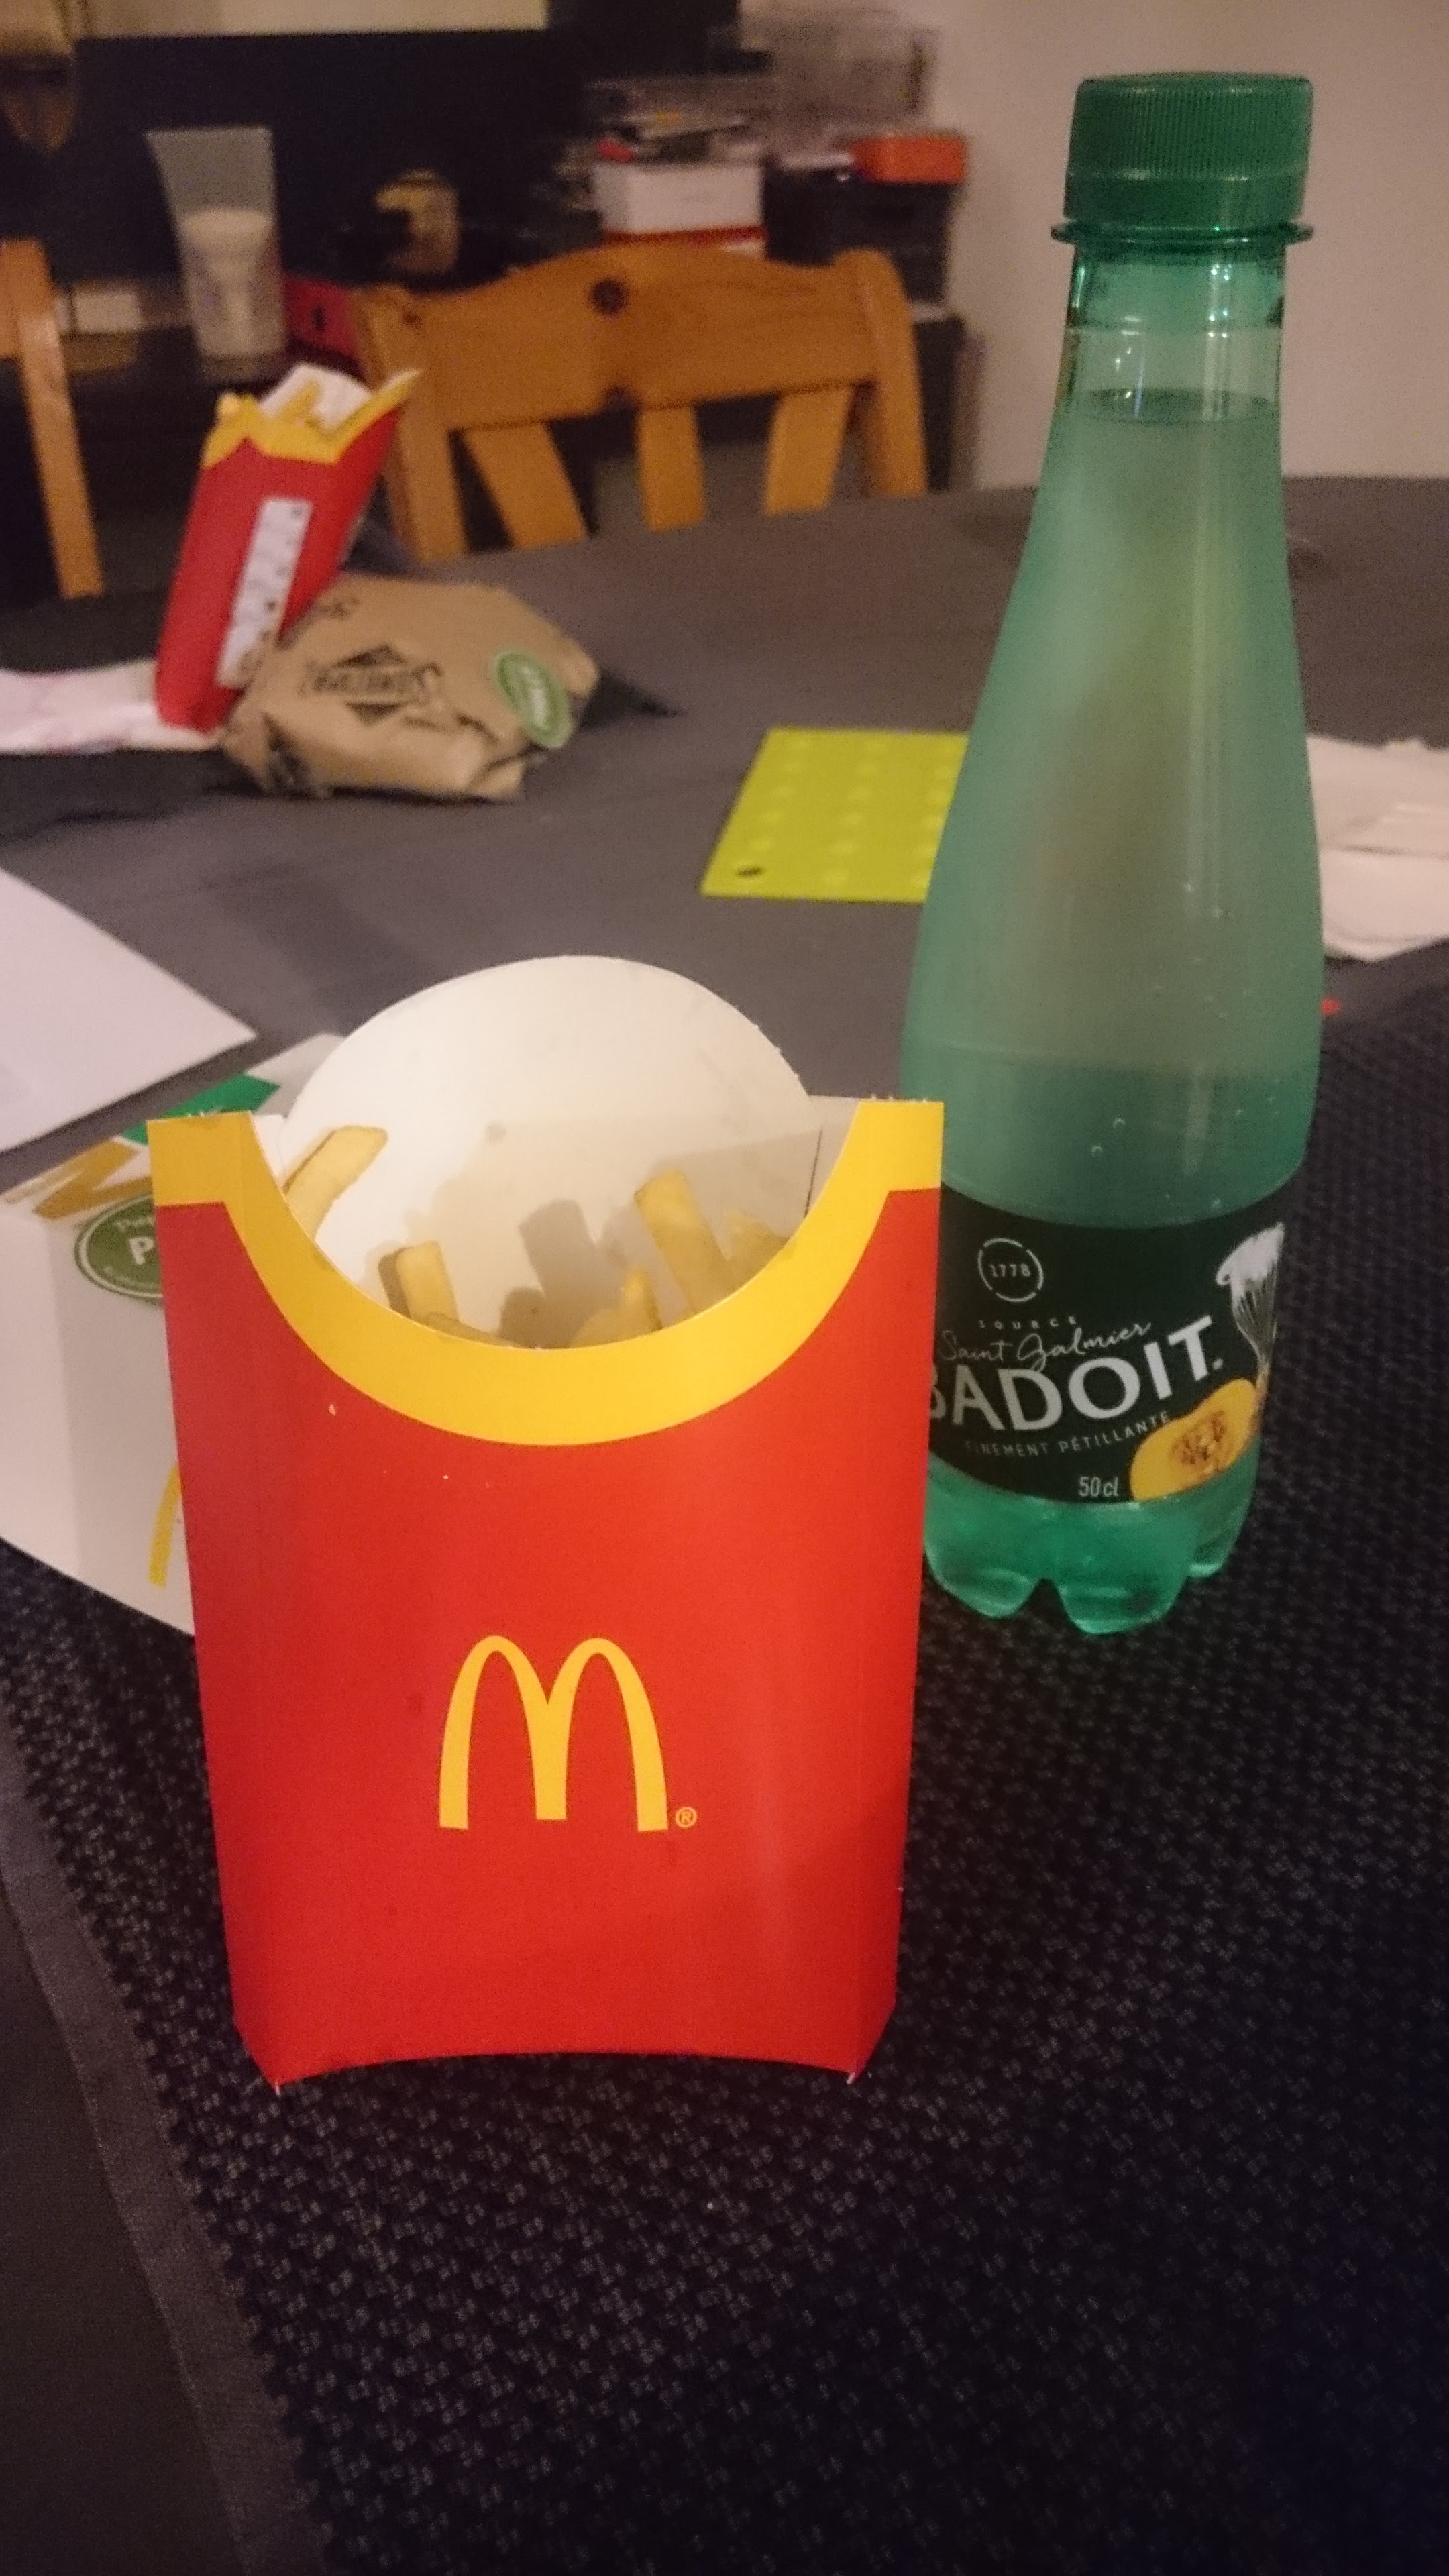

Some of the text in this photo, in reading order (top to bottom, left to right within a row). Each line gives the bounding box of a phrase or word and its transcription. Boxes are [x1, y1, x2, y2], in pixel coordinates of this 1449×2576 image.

[990, 1263, 1031, 1277] 1778
[941, 1330, 1012, 1362] Saint
[1078, 1475, 1119, 1497] 50cl
